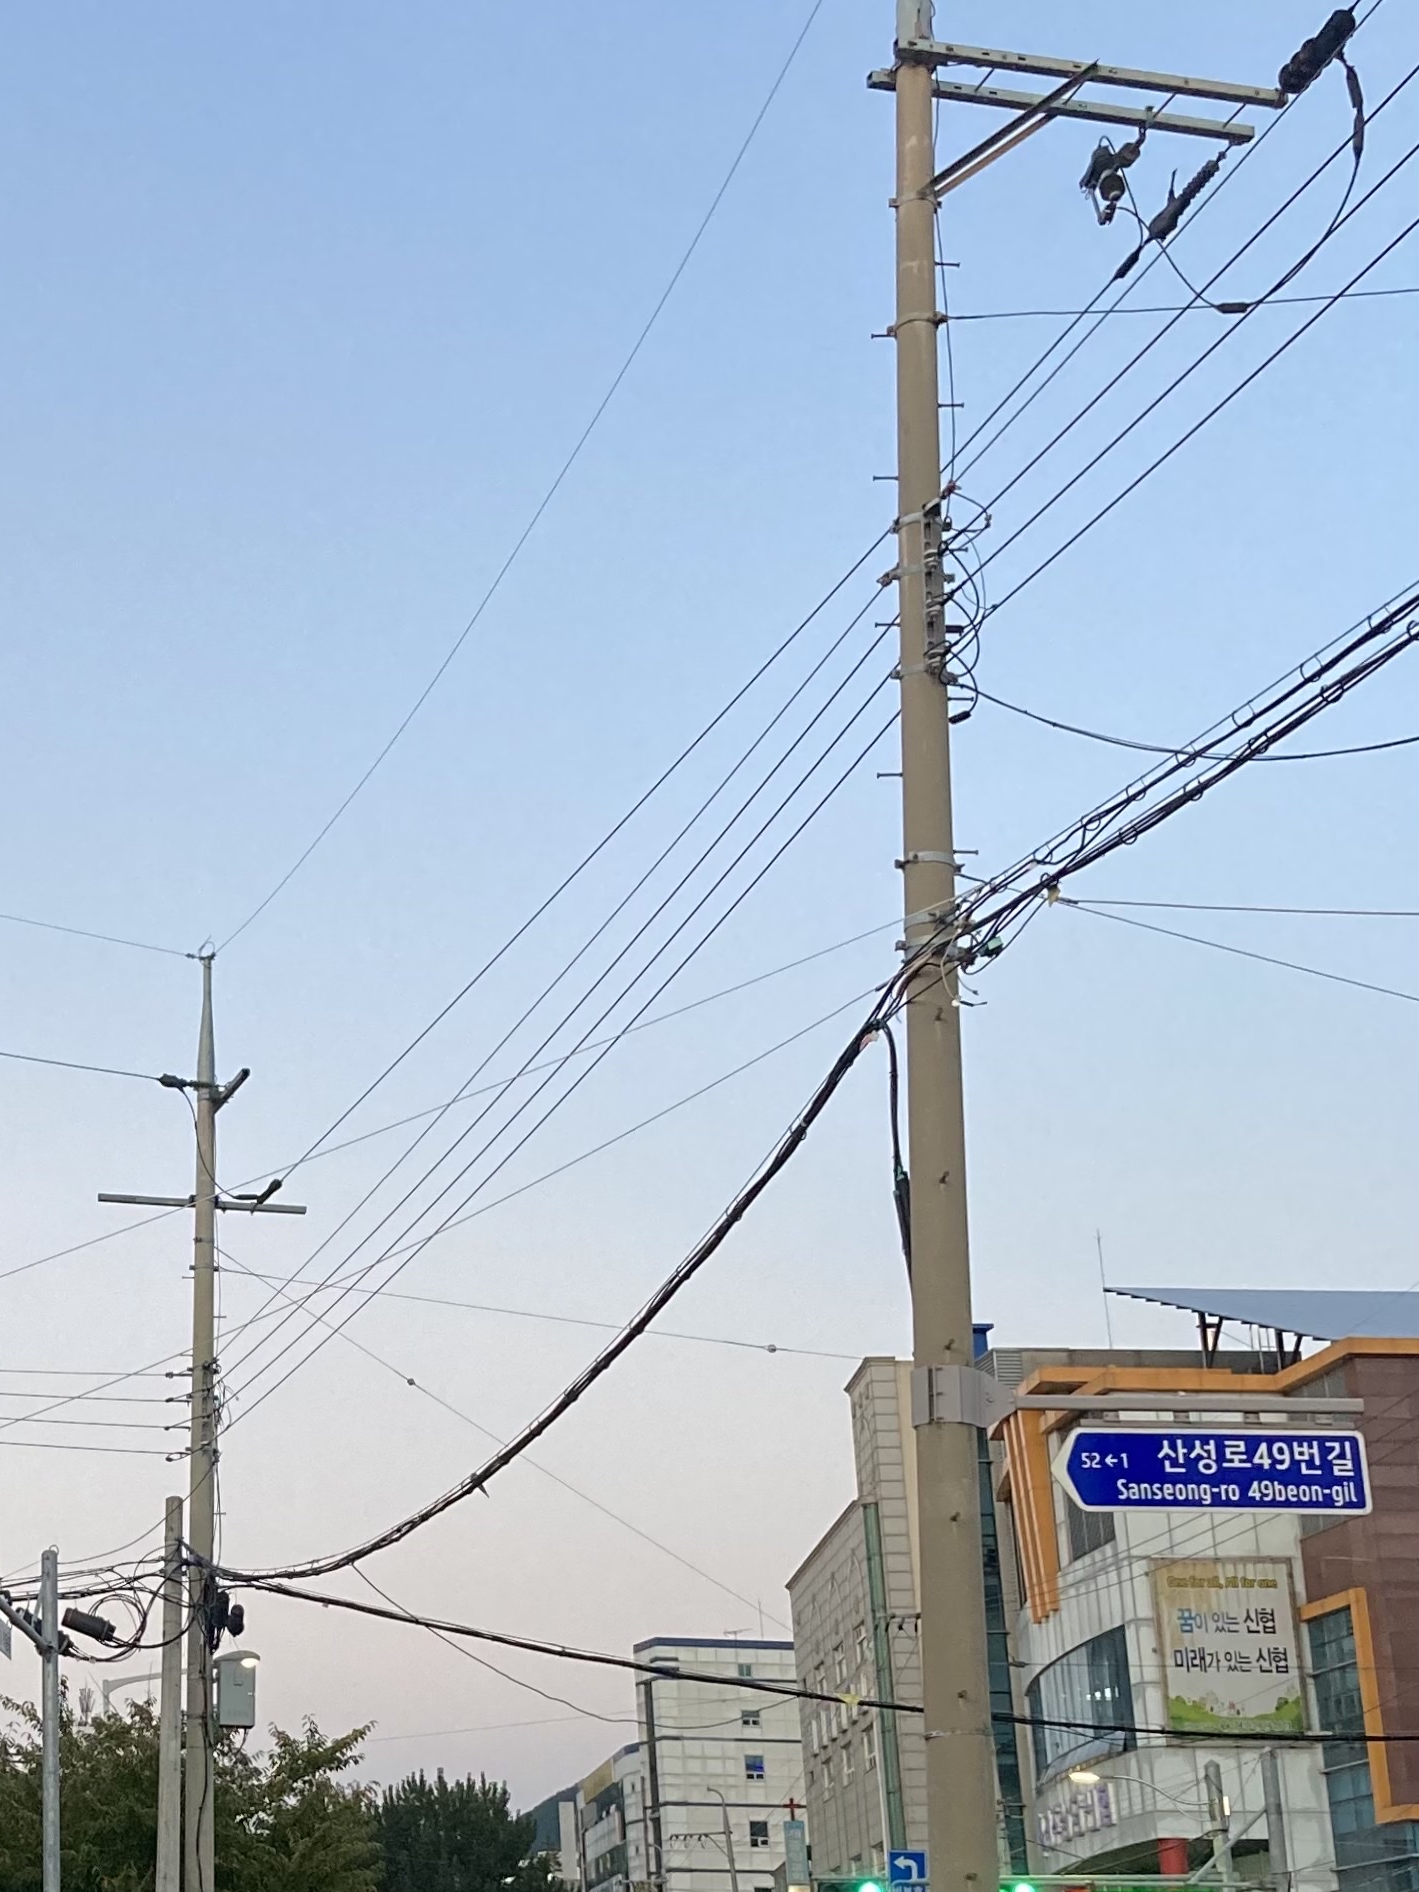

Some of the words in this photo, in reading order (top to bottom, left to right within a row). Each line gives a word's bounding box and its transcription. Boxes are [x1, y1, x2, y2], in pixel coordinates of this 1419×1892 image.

[1080, 1453, 1102, 1469] 52
[1157, 1439, 1356, 1477] 산성로49번길
[1116, 1479, 1240, 1505] Sanseong-ro
[1247, 1480, 1358, 1506] 49beon-gil
[1177, 1607, 1208, 1633] 꿈이
[1211, 1611, 1240, 1633] 있는
[1244, 1608, 1277, 1634] 신협
[1173, 1646, 1221, 1673] 미래가
[1224, 1650, 1252, 1672] 있는
[1256, 1647, 1289, 1674] 신협
